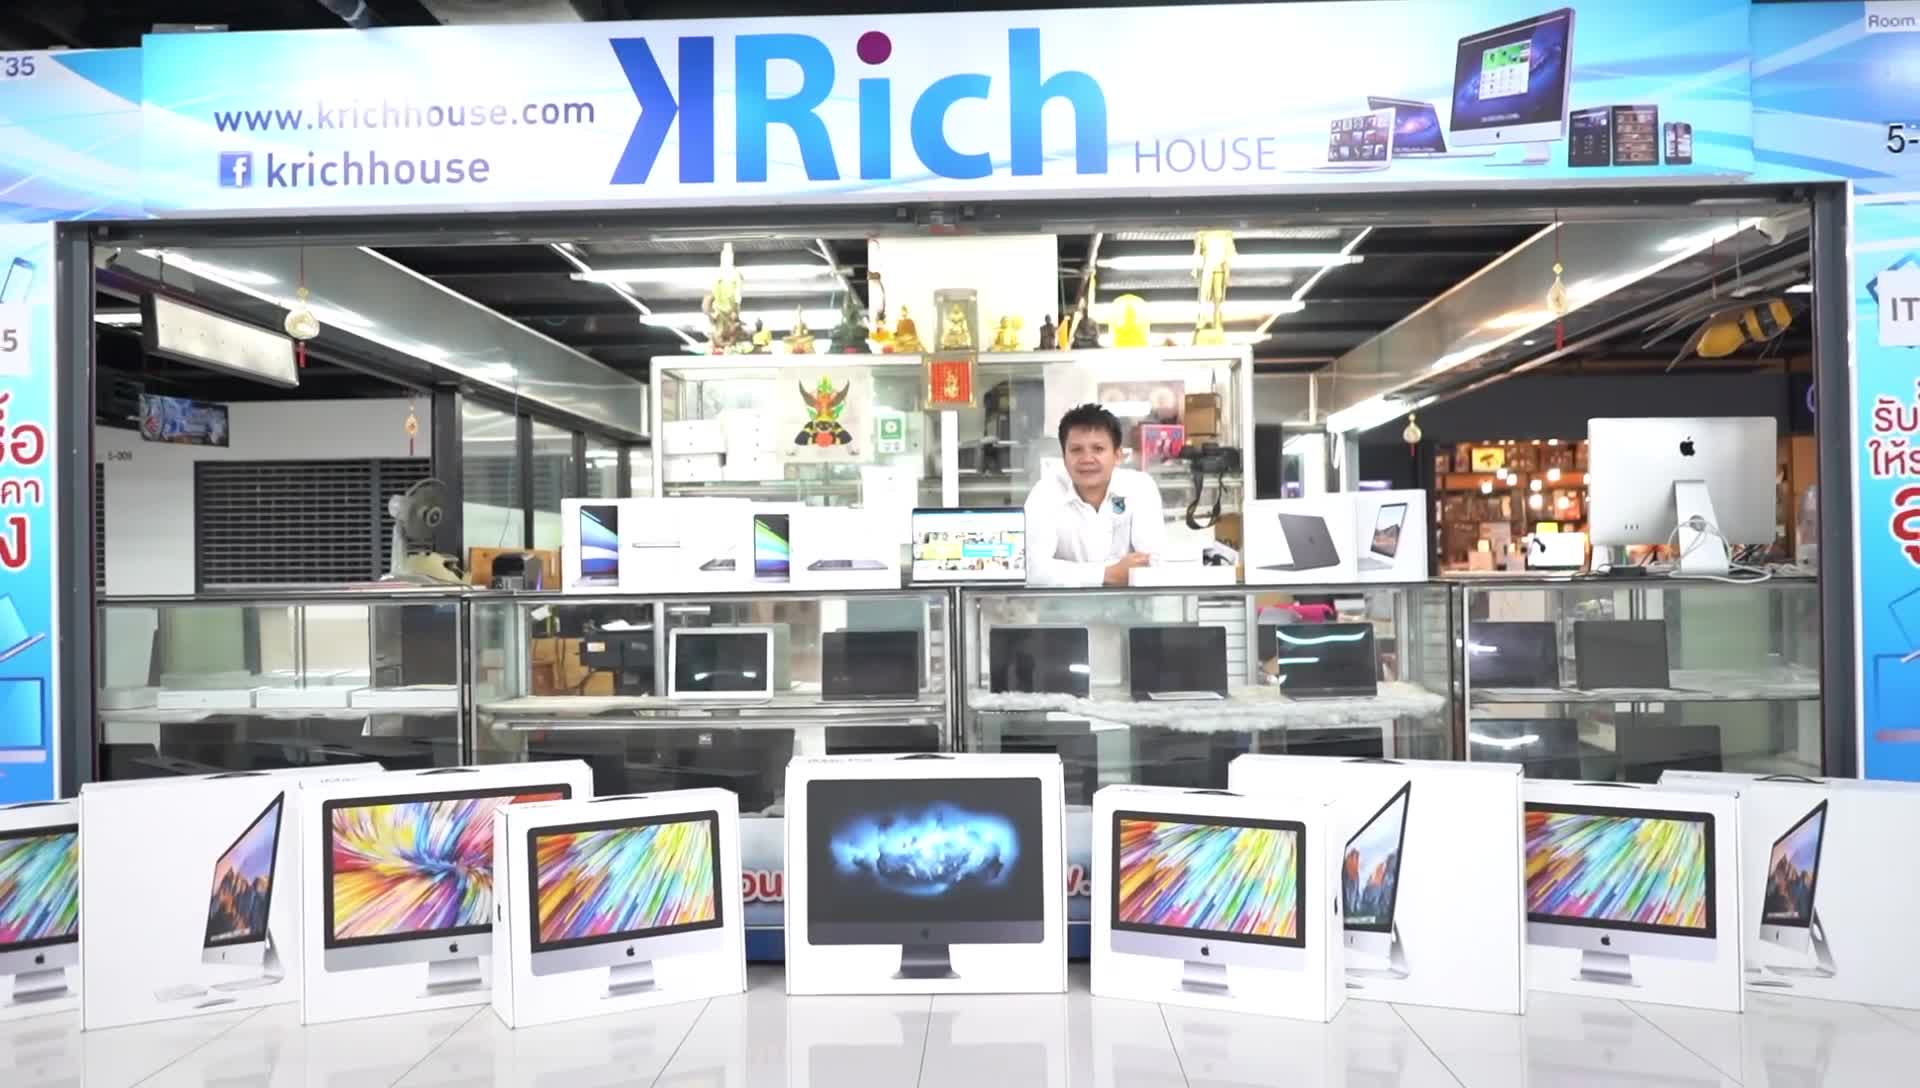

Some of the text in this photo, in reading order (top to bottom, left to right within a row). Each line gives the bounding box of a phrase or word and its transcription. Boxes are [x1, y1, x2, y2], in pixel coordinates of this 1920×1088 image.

[1868, 14, 1916, 28] Room
[213, 99, 595, 132] www.krichhouse.com
[608, 27, 1278, 185] KRich HOUSE
[266, 150, 490, 188] krichhouse
